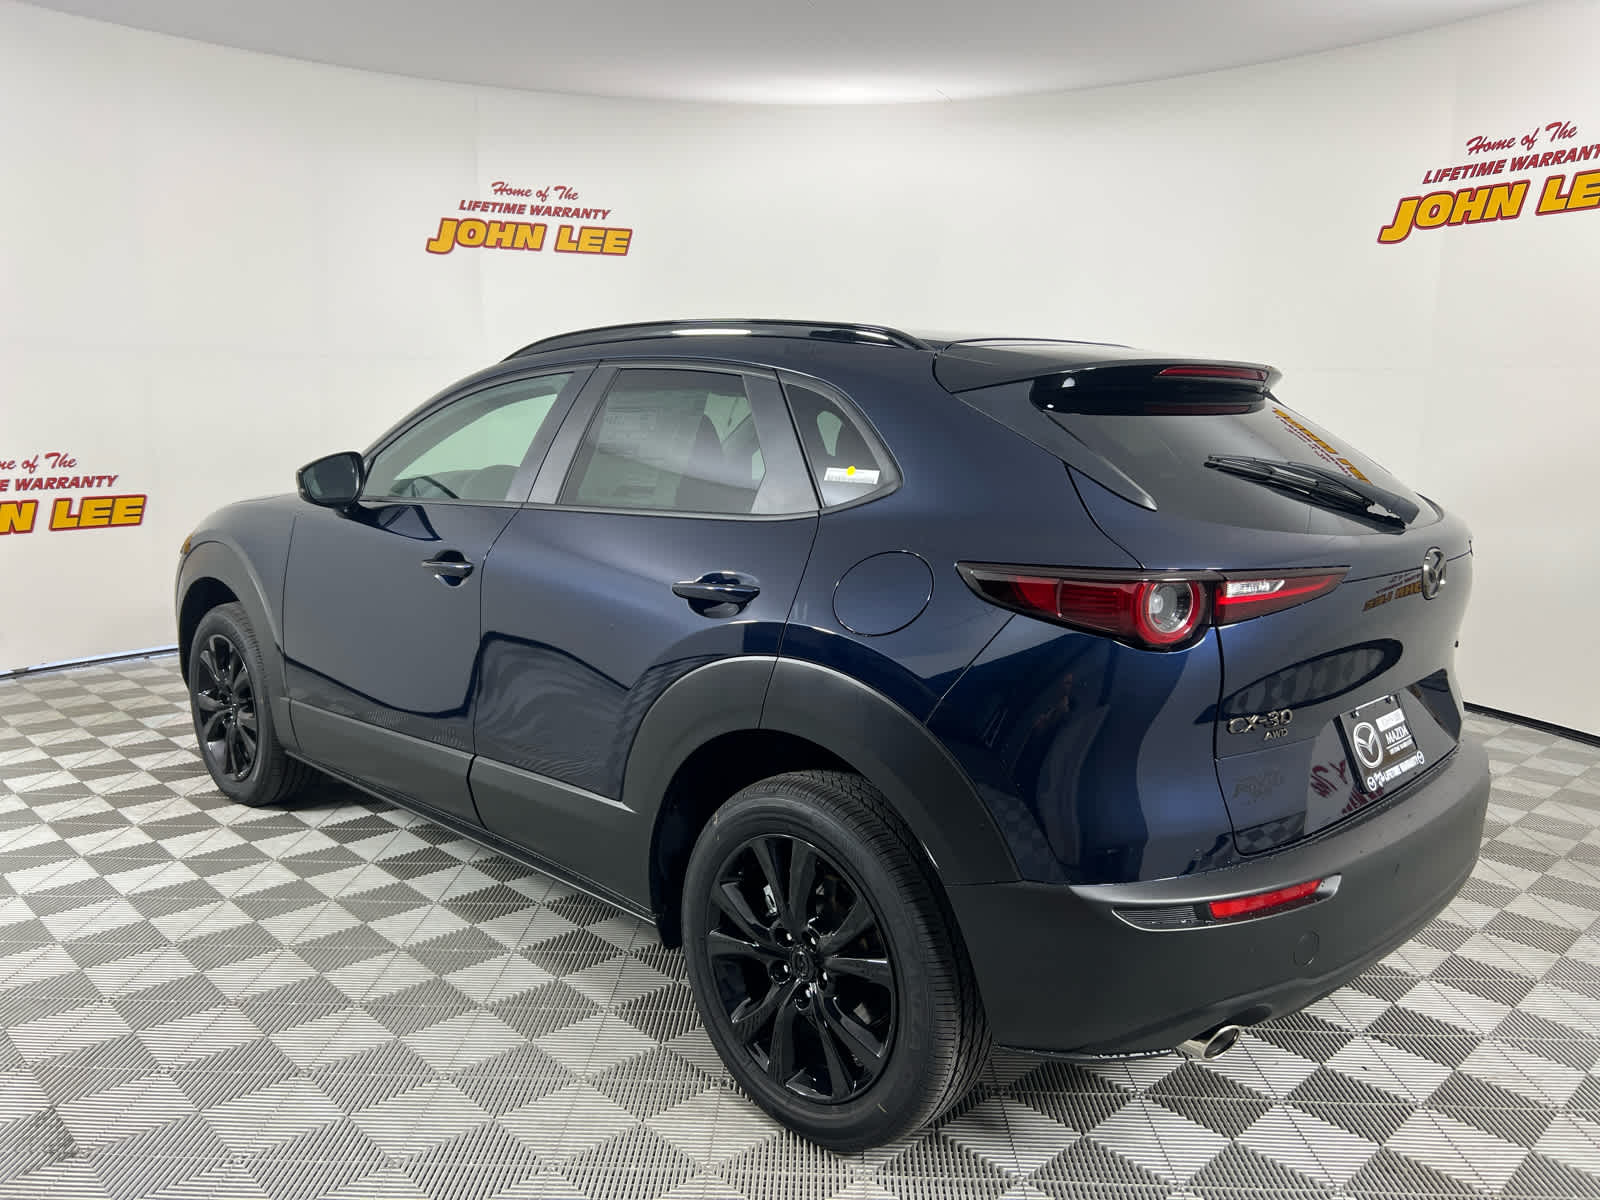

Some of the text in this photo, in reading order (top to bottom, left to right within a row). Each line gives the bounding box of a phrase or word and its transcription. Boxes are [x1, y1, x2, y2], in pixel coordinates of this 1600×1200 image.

[1466, 120, 1578, 156] Home of The
[1422, 159, 1507, 184] LIFETIME
[492, 181, 579, 202] Home of The
[458, 199, 611, 220] LIFETIME WARRANTY
[1377, 179, 1531, 244] JOHN
[425, 217, 633, 257] JOHN LEE
[21, 454, 39, 474] of
[44, 452, 77, 469] The
[15, 475, 119, 491] WARRANTY
[49, 494, 147, 531] LEE
[1228, 708, 1293, 735] CX-30
[1264, 728, 1288, 741] AWD
[1385, 723, 1409, 745] MAZDA
